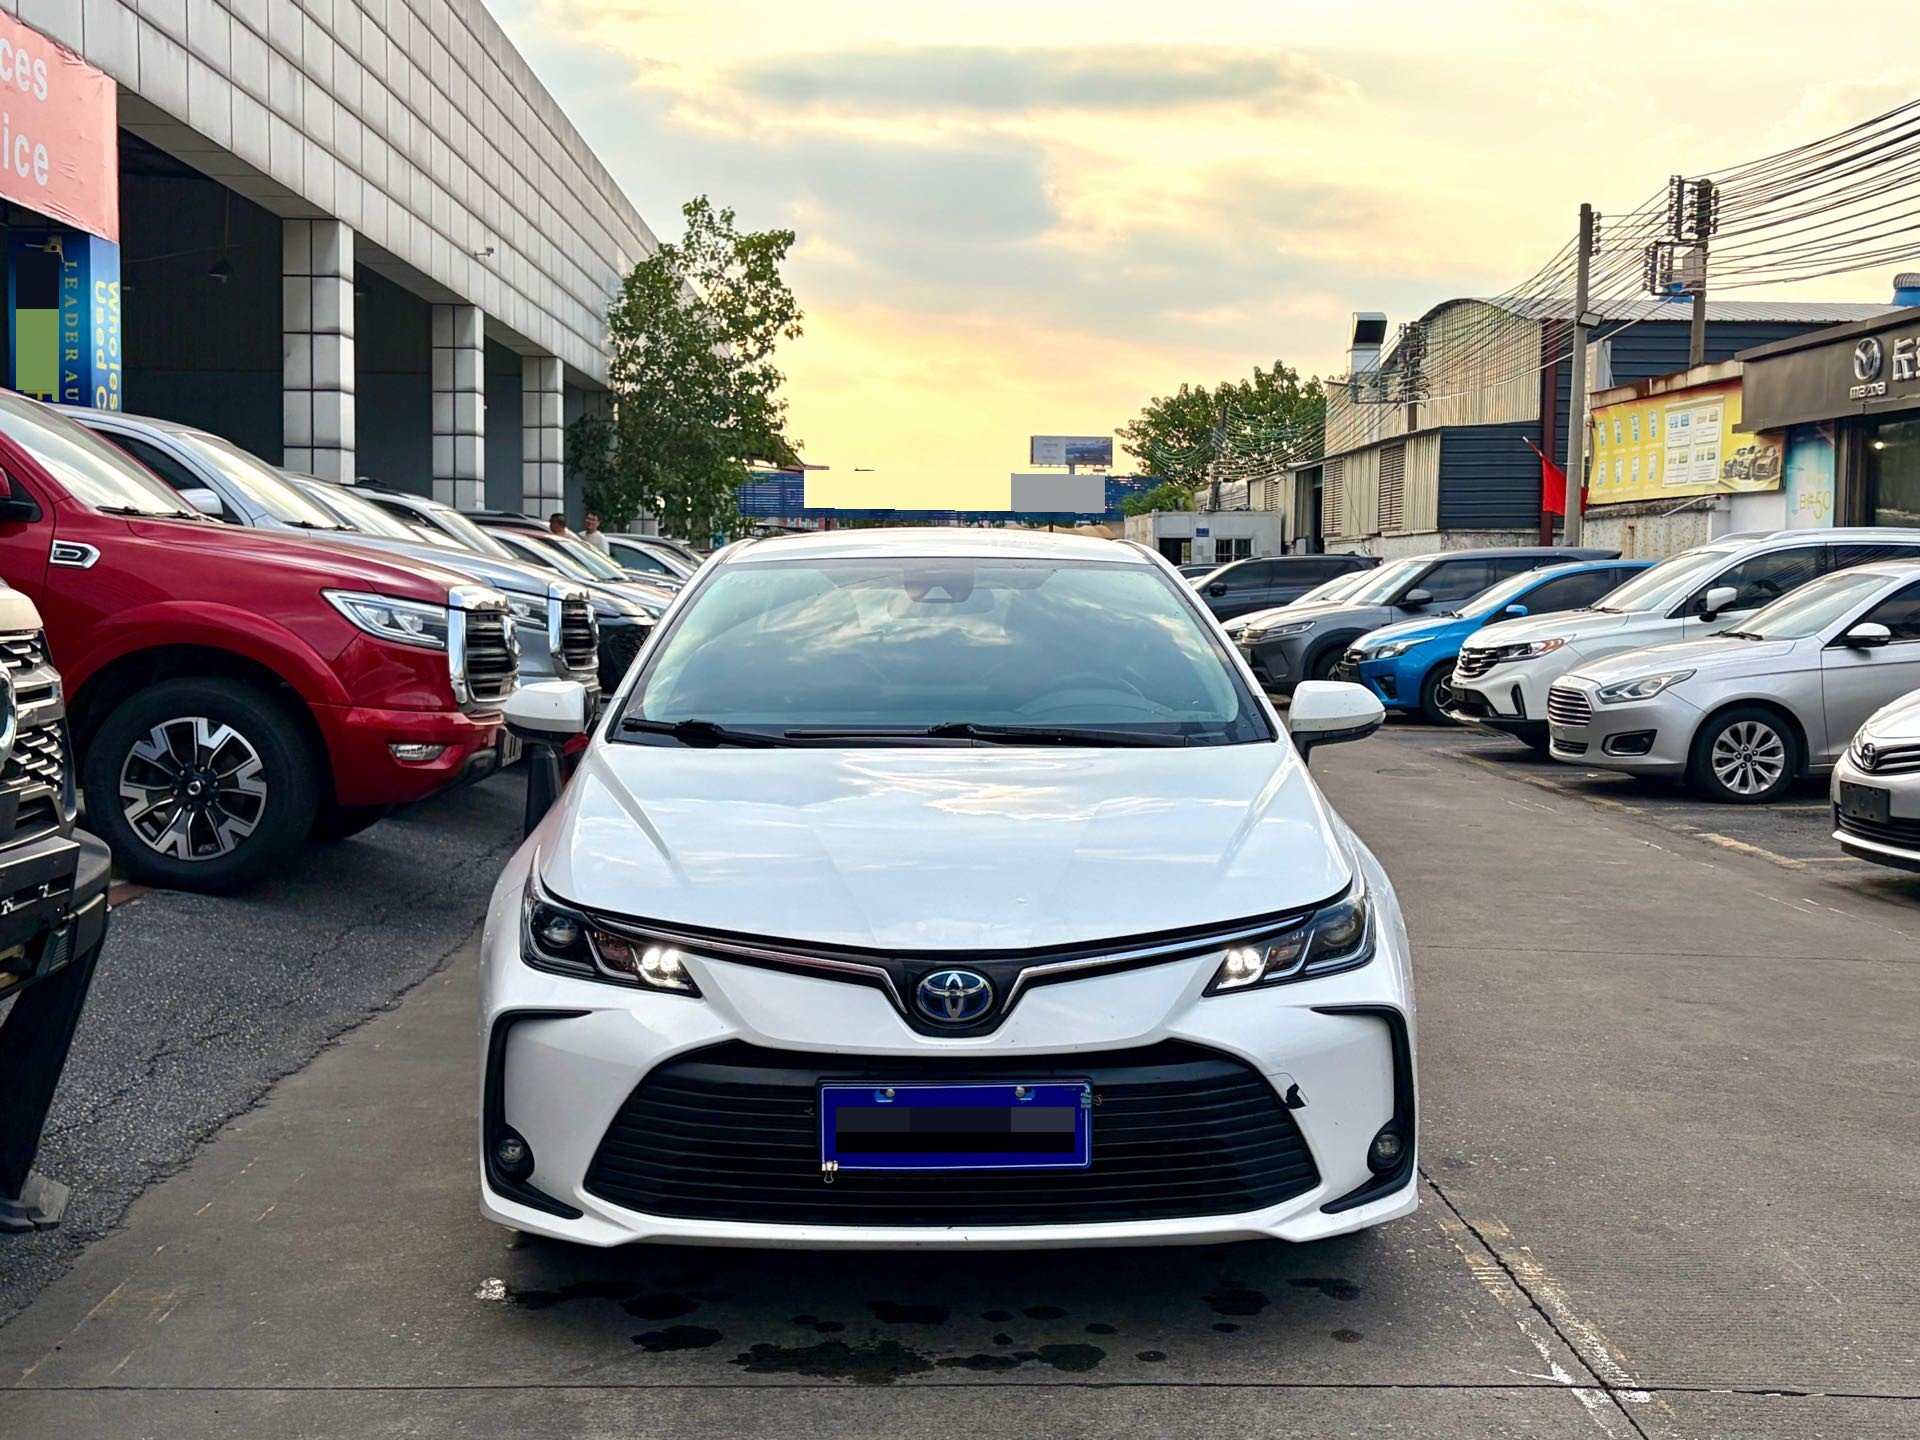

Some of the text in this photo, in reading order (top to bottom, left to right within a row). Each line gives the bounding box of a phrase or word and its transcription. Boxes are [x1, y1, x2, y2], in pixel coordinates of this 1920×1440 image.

[0, 38, 48, 101] ces
[3, 112, 48, 186] ice
[64, 261, 79, 401] LEADER AU
[95, 280, 107, 370] Used
